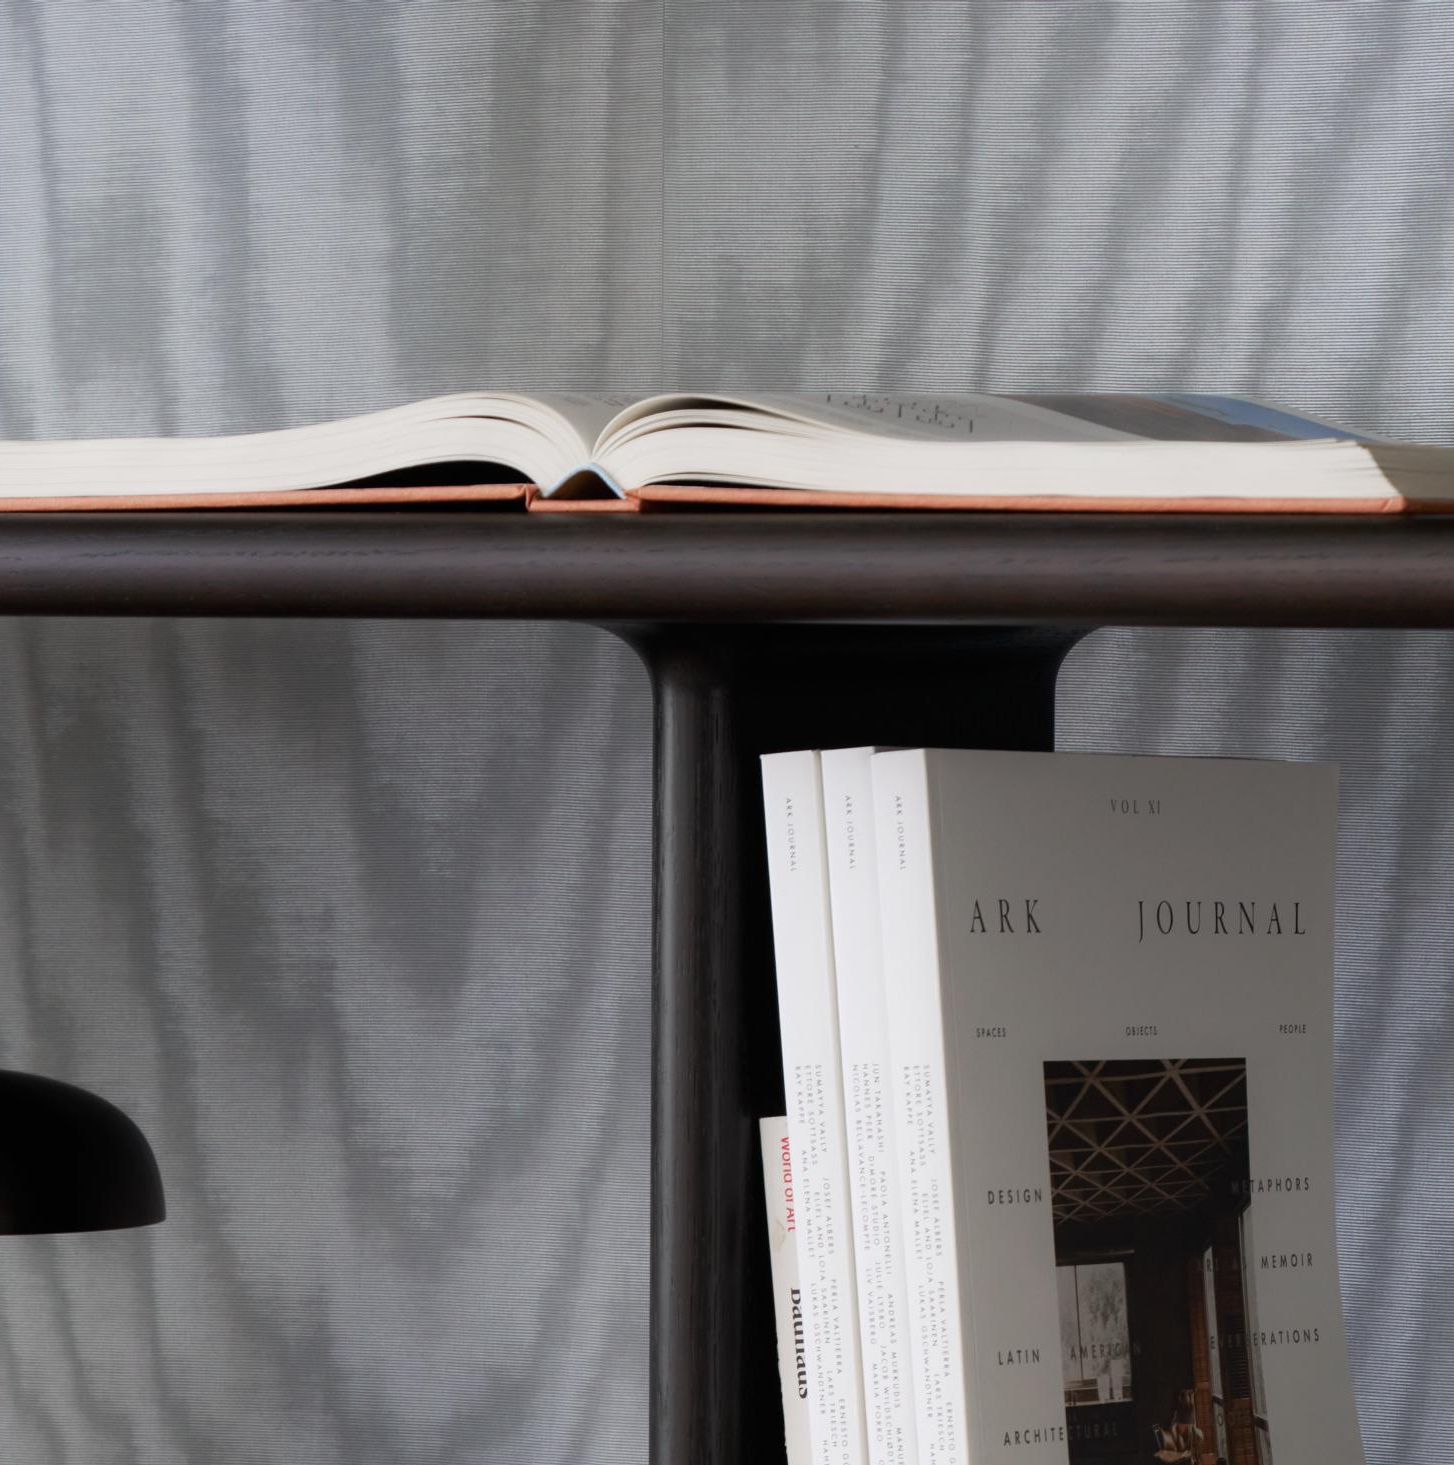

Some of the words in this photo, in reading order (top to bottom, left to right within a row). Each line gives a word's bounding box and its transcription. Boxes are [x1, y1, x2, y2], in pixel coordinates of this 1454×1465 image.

[845, 795, 853, 815] ARK
[1110, 799, 1139, 815] VOL
[1148, 799, 1161, 815] XI
[787, 823, 797, 872] JOURNAL
[846, 821, 856, 869] JOURNAL
[897, 822, 906, 870] JOURNAL
[970, 898, 1043, 934] ARK
[1137, 900, 1307, 944] JOURNAL
[976, 1026, 1007, 1039] SPACES
[1125, 1025, 1158, 1037] OBJECTS
[1279, 1023, 1307, 1035] PEOPLE
[907, 1150, 917, 1173] ANA
[912, 1065, 923, 1105] ETTORE
[922, 1227, 932, 1250] AND
[988, 1188, 1044, 1206] DESIGN
[1260, 1253, 1314, 1270] MEMOIR
[926, 1122, 936, 1154] VALLY
[932, 1216, 942, 1256] ALBERS
[944, 1401, 955, 1451] ERNESTO
[997, 1349, 1042, 1367] LATIN
